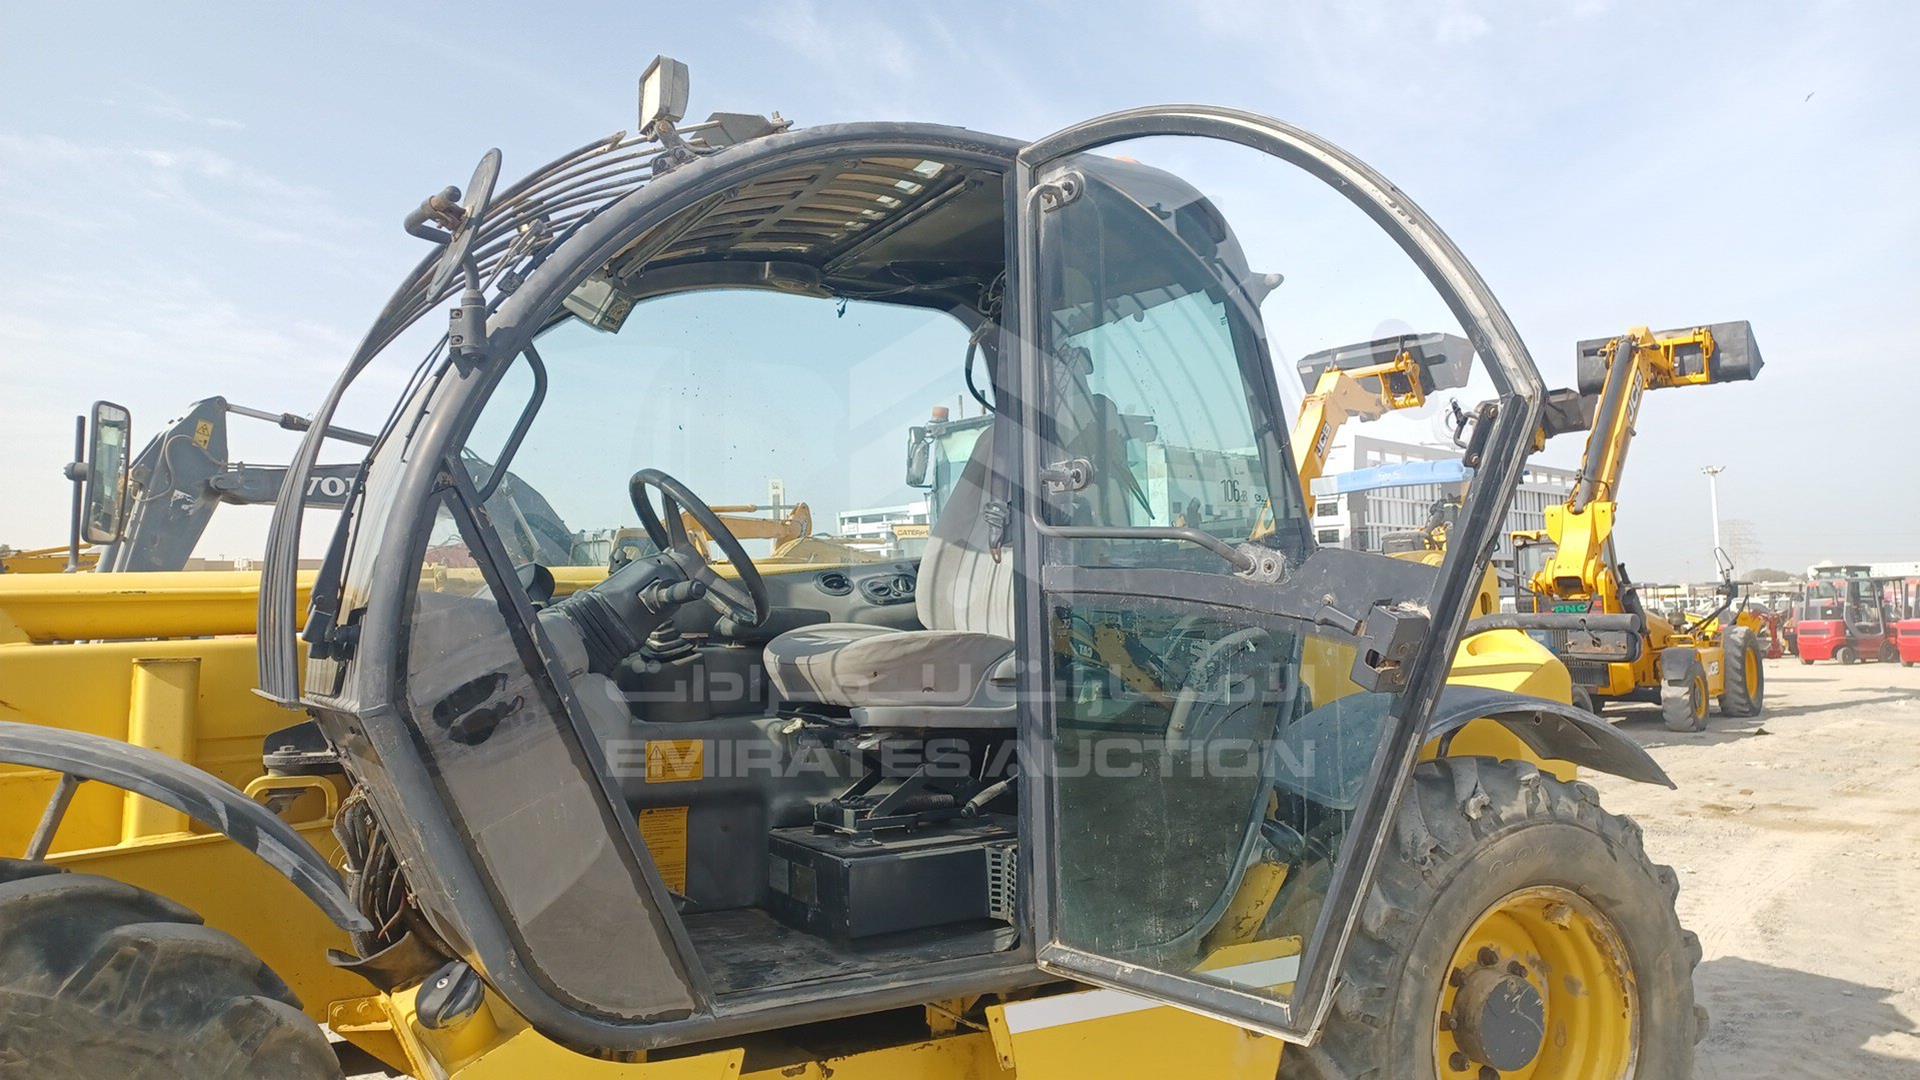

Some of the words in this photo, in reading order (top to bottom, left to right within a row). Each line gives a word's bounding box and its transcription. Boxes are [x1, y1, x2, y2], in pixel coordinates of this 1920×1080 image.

[1628, 369, 1643, 423] JCB
[1317, 421, 1331, 457] JCB
[1221, 479, 1240, 502] 106
